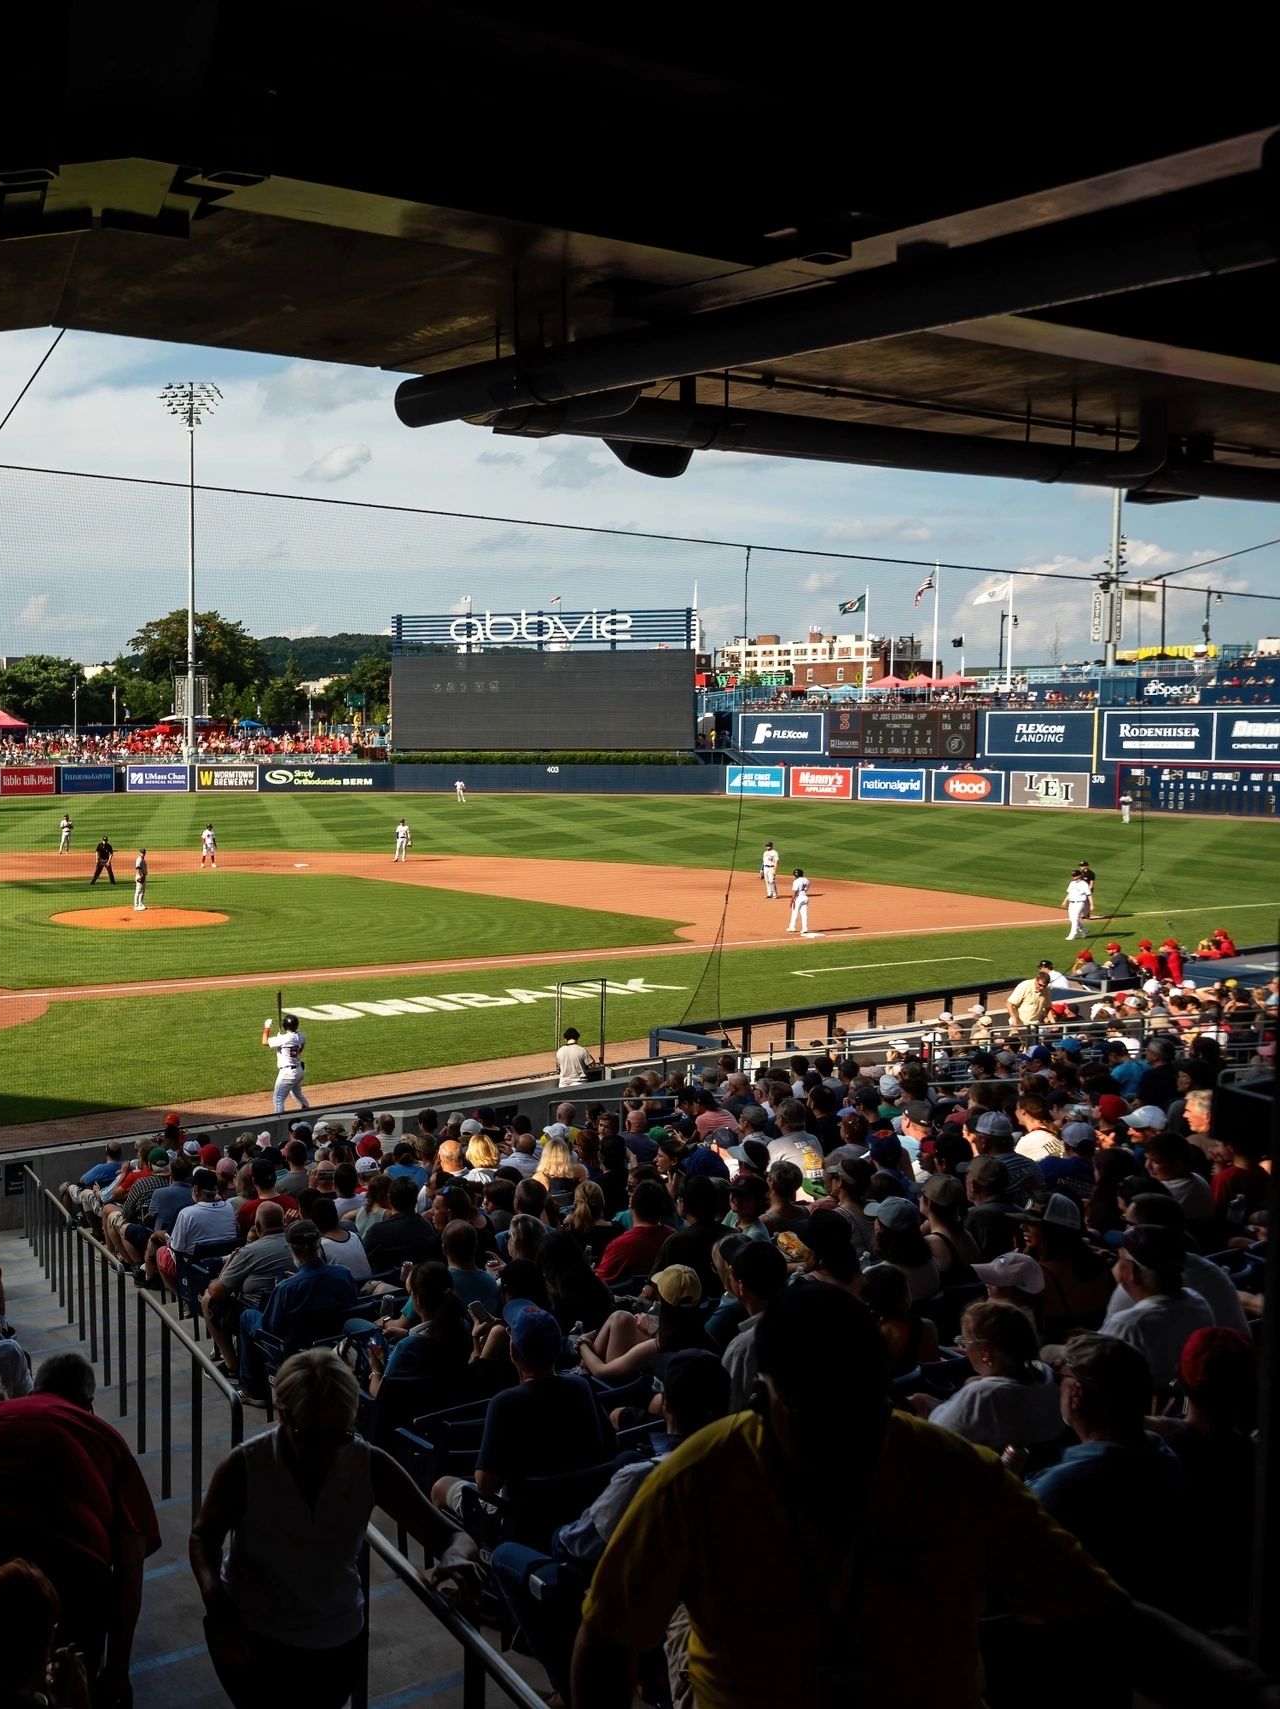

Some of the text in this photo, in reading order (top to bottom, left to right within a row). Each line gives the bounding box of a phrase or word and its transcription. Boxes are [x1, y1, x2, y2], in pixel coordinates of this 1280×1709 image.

[450, 607, 633, 643] abbvie
[1119, 723, 1200, 738] RODENHISER
[1014, 733, 1064, 743] LANDING
[168, 772, 186, 780] Chan
[214, 771, 254, 779] WORMTOWN
[294, 770, 315, 778] Simply
[546, 766, 559, 774] 403
[2, 775, 54, 786] Table Talk Pies
[200, 771, 213, 786] W
[294, 778, 373, 786] Orthodontics BERM
[799, 771, 844, 786] Manny's
[1091, 775, 1105, 784] 370
[862, 779, 920, 793] nationalgrid
[949, 780, 986, 794] Hood
[1024, 773, 1074, 802] LEI
[281, 977, 690, 1021] UNIBANK
